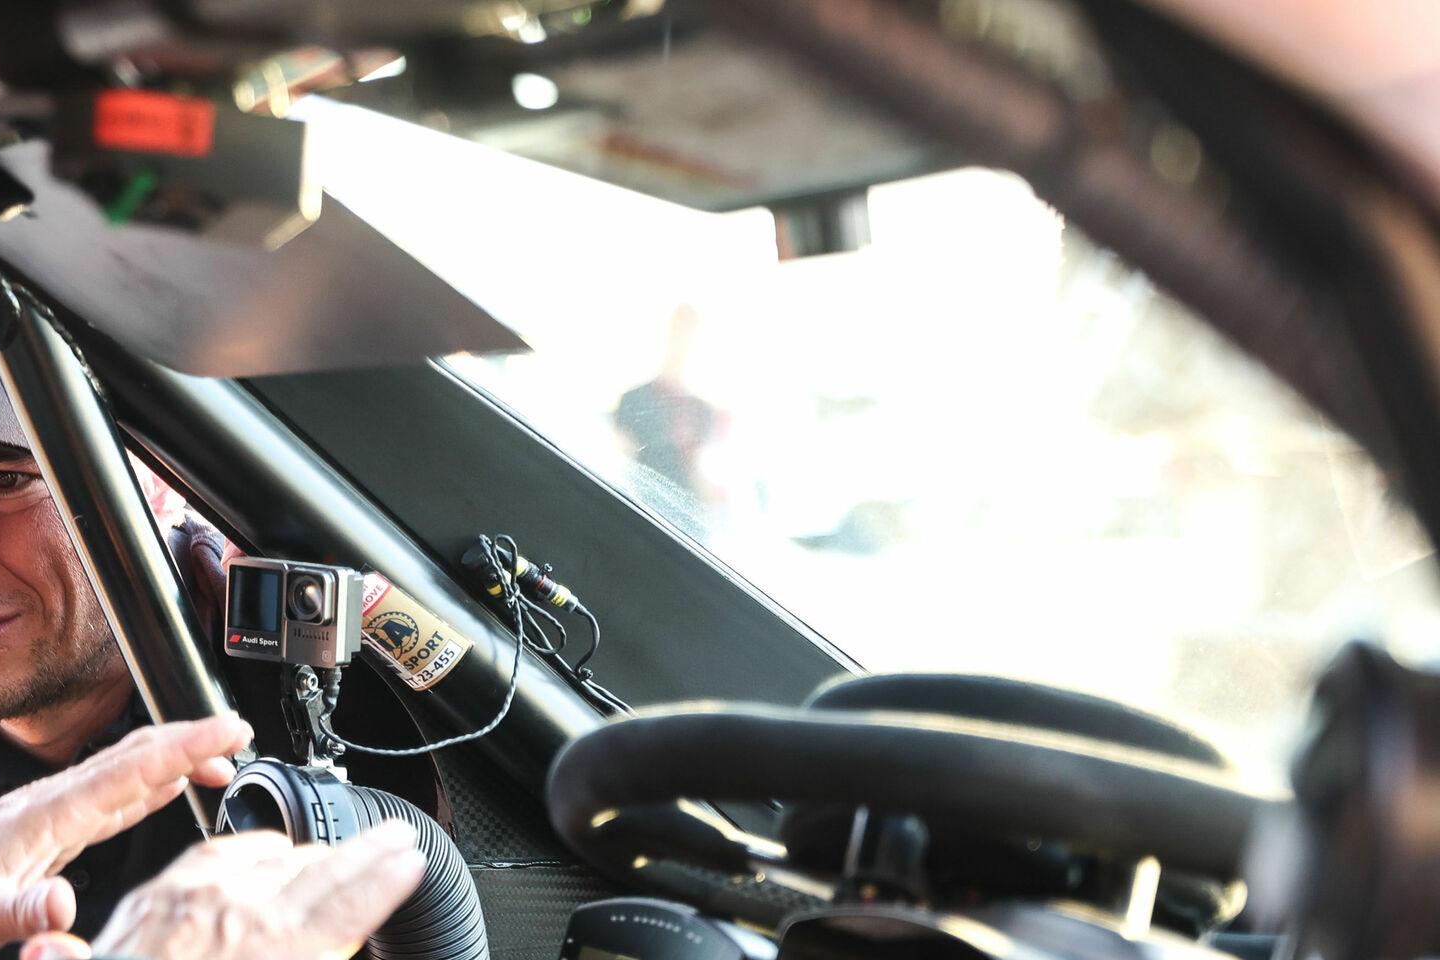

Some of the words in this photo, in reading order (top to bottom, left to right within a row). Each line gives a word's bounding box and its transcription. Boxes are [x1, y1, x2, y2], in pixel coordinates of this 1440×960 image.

[242, 635, 258, 645] Audi
[259, 637, 278, 648] Sport
[403, 630, 445, 670] SPORT
